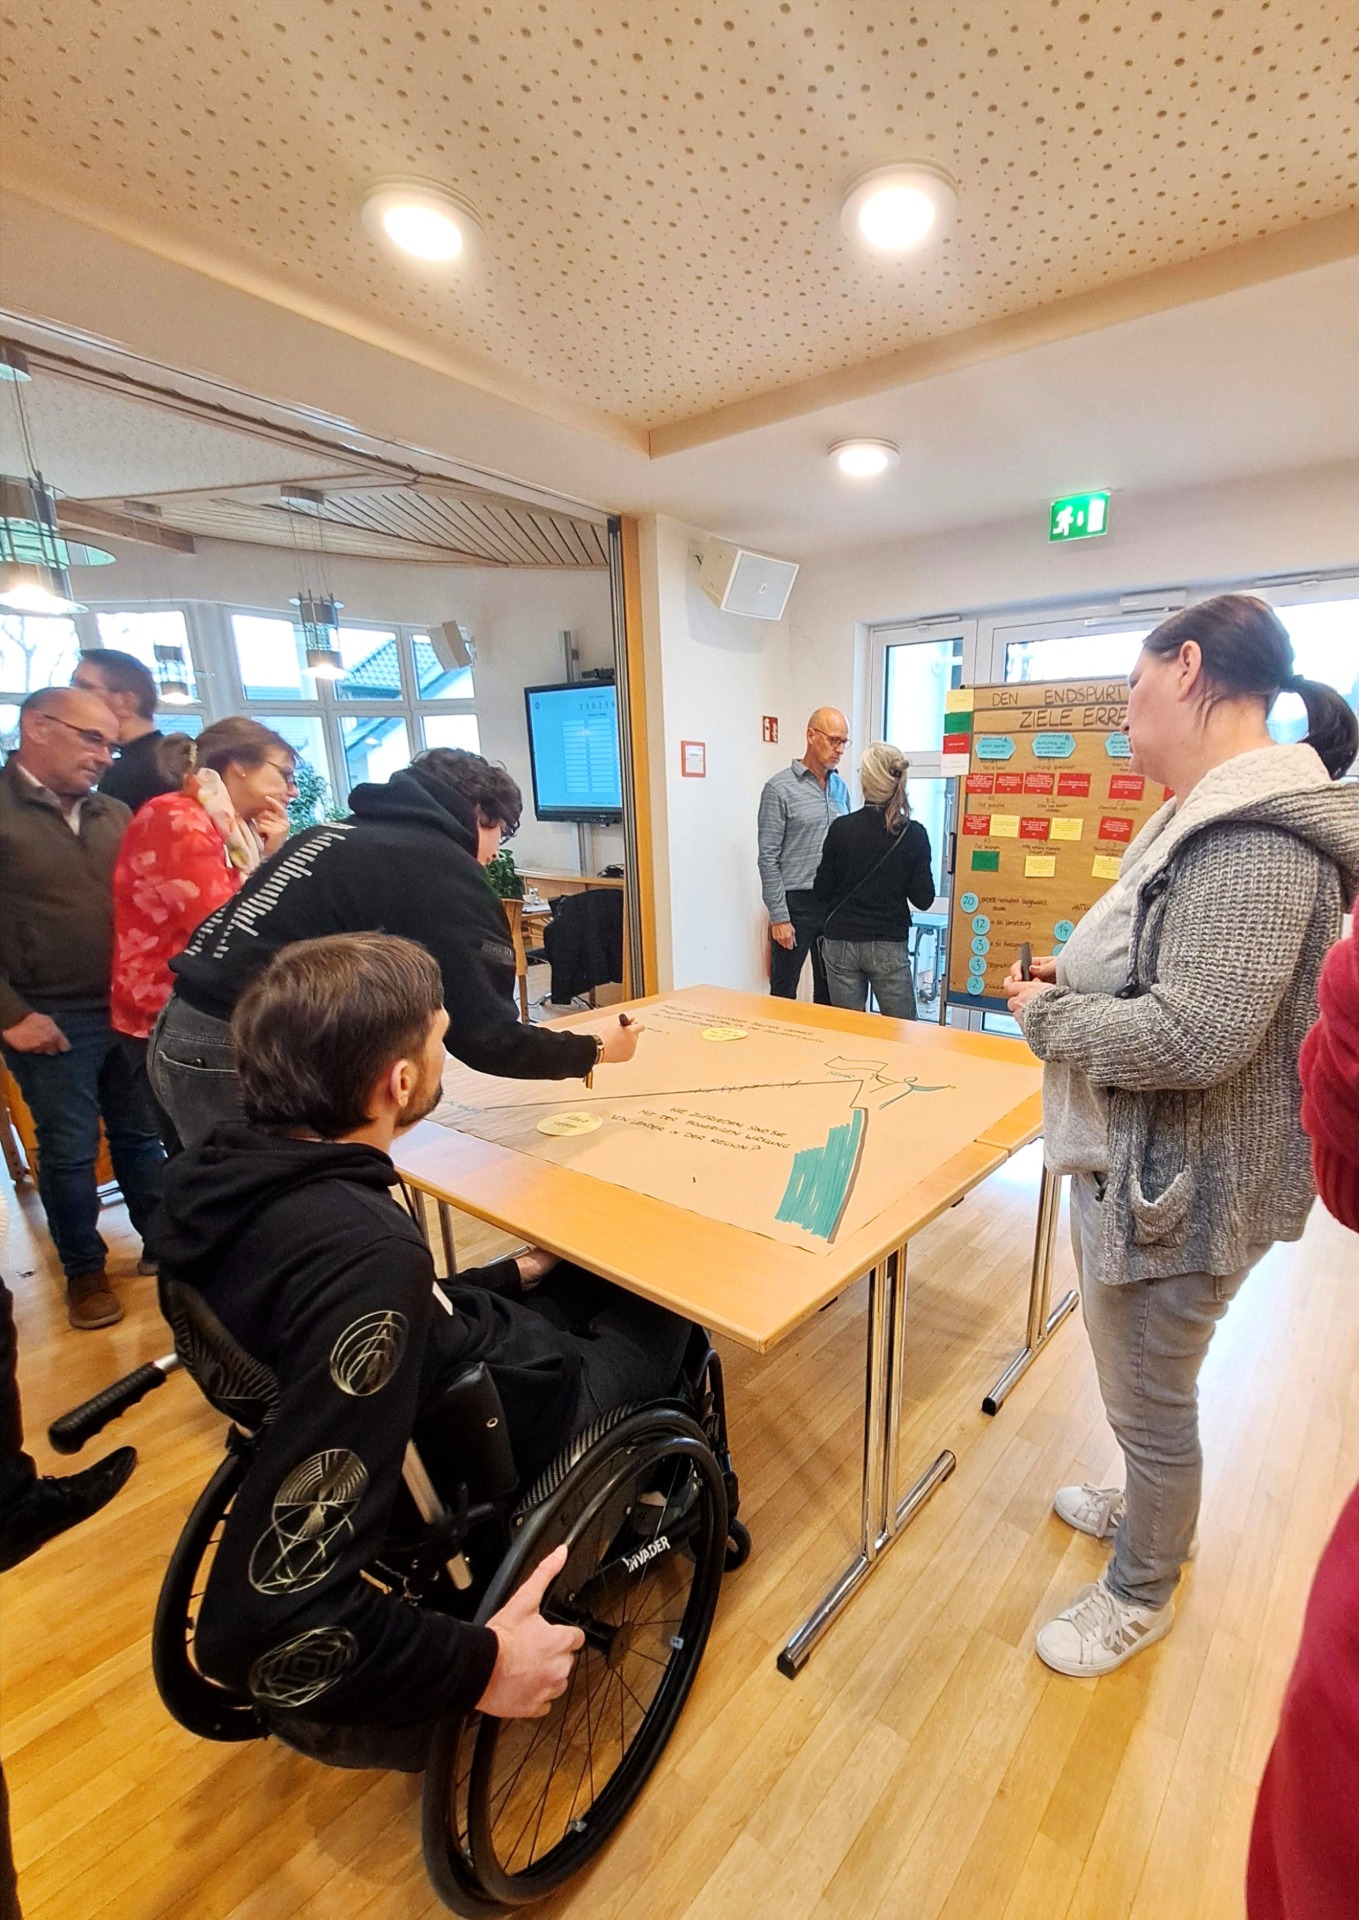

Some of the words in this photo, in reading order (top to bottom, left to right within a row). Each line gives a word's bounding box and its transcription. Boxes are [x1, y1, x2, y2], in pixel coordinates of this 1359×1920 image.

[992, 691, 1019, 707] DEN
[1044, 684, 1128, 705] ENDSPURT
[1019, 708, 1074, 728] ZIELE
[963, 896, 975, 905] 20
[975, 918, 986, 928] 12
[977, 939, 984, 951] 3
[972, 977, 979, 989] 2
[621, 1535, 671, 1573] INVADER
